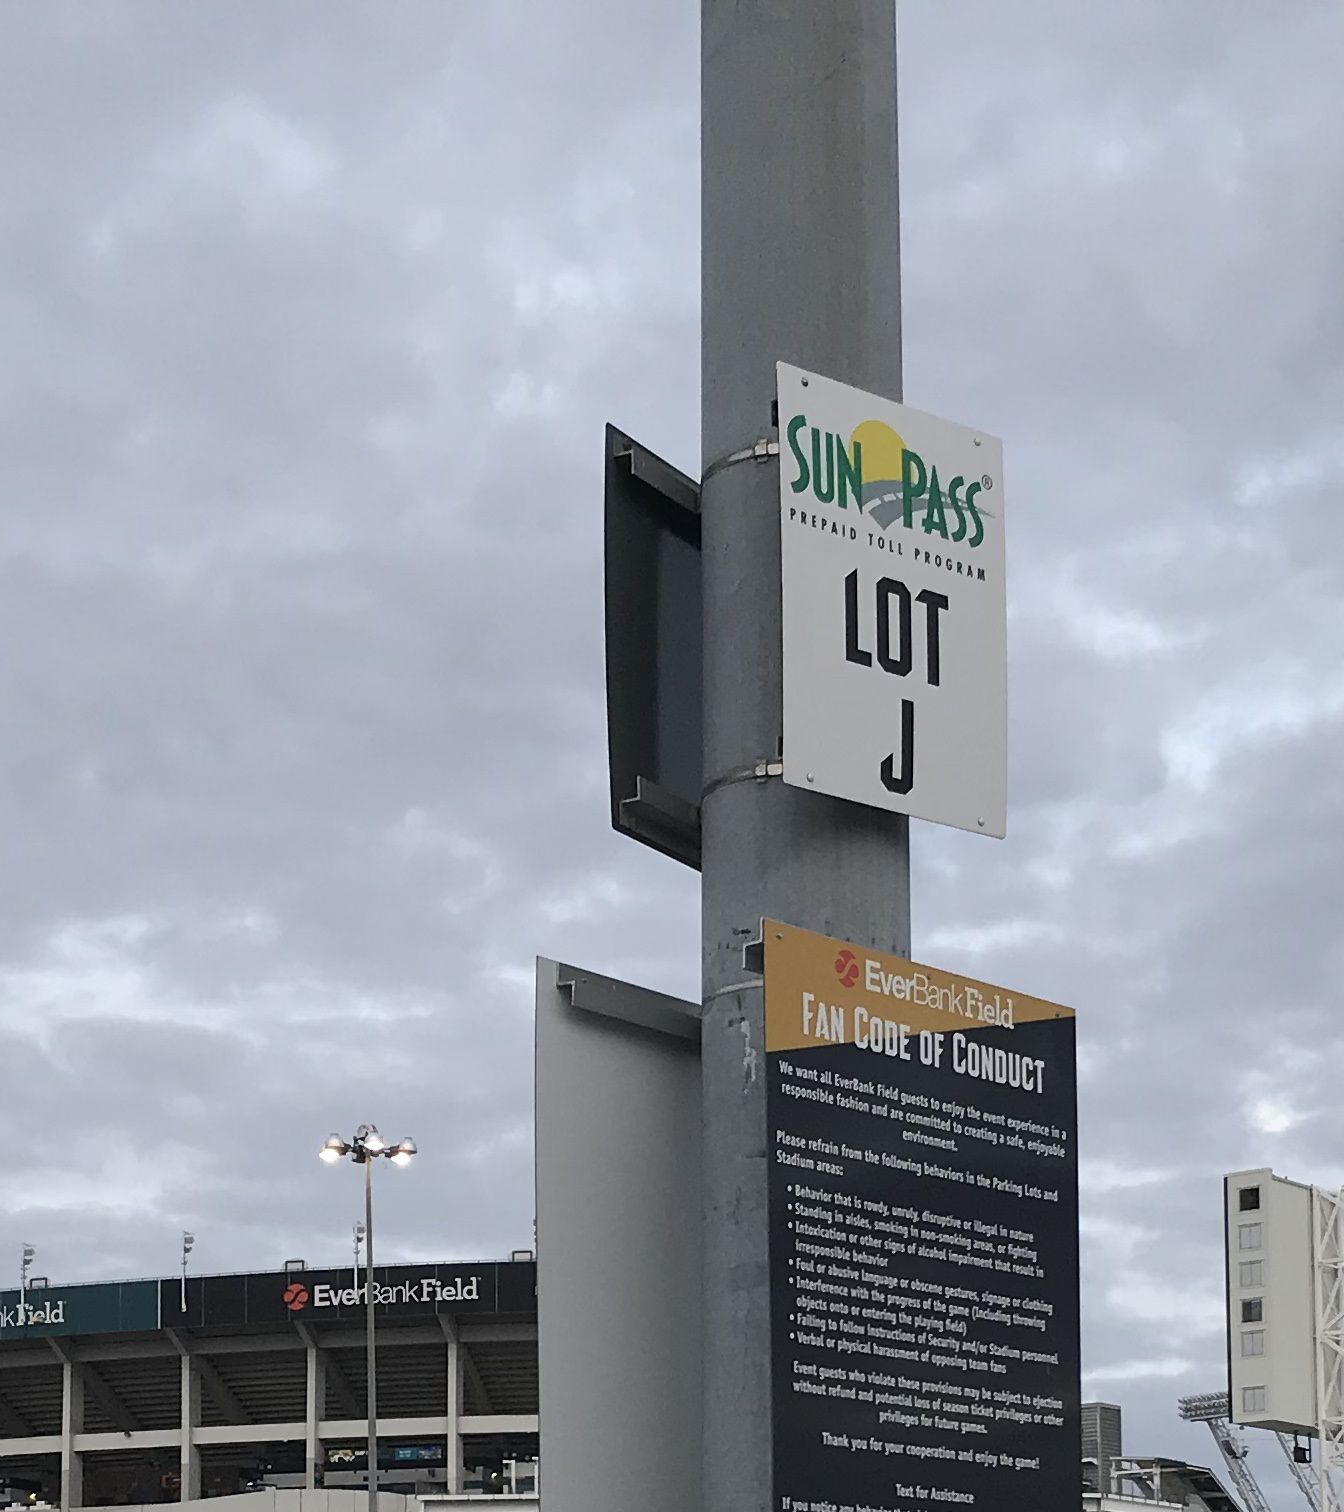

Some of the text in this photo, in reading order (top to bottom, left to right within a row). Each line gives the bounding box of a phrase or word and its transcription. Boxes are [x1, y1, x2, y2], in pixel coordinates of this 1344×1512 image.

[789, 507, 986, 582] PREPAID TOLL PROGRAM
[844, 567, 949, 687] LOT
[880, 698, 914, 796] J
[964, 986, 1014, 1030] Field
[778, 1060, 1066, 1140] We want all EverBank Field guests to enjoy the event experience in a
[781, 1083, 833, 1104] responsible
[836, 1092, 869, 1112] fashion
[871, 1104, 887, 1116] and
[890, 1108, 903, 1120] are
[905, 1112, 950, 1131] committed
[952, 1121, 962, 1134] to
[964, 1126, 997, 1144] creating
[999, 1134, 1004, 1143] a
[1027, 1139, 1065, 1157] enjoyable
[776, 1149, 814, 1169] Stadium
[776, 1129, 1058, 1202] Please refrain from the following behaviors in the Parking Lots and
[794, 1184, 832, 1202] Behavior
[833, 1192, 852, 1207] that
[853, 1195, 861, 1208] is
[921, 1210, 961, 1228] disruptive
[963, 1220, 972, 1230] or
[973, 1219, 997, 1237] illegal
[999, 1224, 1007, 1237] in
[1009, 1229, 1033, 1242] nature
[795, 1220, 846, 1241] Intoxication
[848, 1233, 858, 1243] or
[859, 1234, 882, 1248] other
[884, 1237, 905, 1254] signs
[907, 1242, 916, 1254] of
[917, 1244, 946, 1260] alcohol
[994, 1259, 1010, 1272] that
[1012, 1264, 1034, 1276] result
[1035, 1265, 1044, 1278] in
[852, 1249, 888, 1267] behavior
[420, 1277, 478, 1302] Field
[821, 1431, 849, 1447] Thank
[850, 1438, 867, 1451] you
[869, 1437, 882, 1451] for
[884, 1442, 904, 1455] your
[905, 1444, 955, 1459] cooperation
[957, 1448, 973, 1461] and
[974, 1450, 998, 1467] enjoy
[999, 1453, 1013, 1466] the
[782, 1496, 790, 1509] If
[792, 1501, 808, 1512] you
[895, 1483, 974, 1503] Text for Assistance
